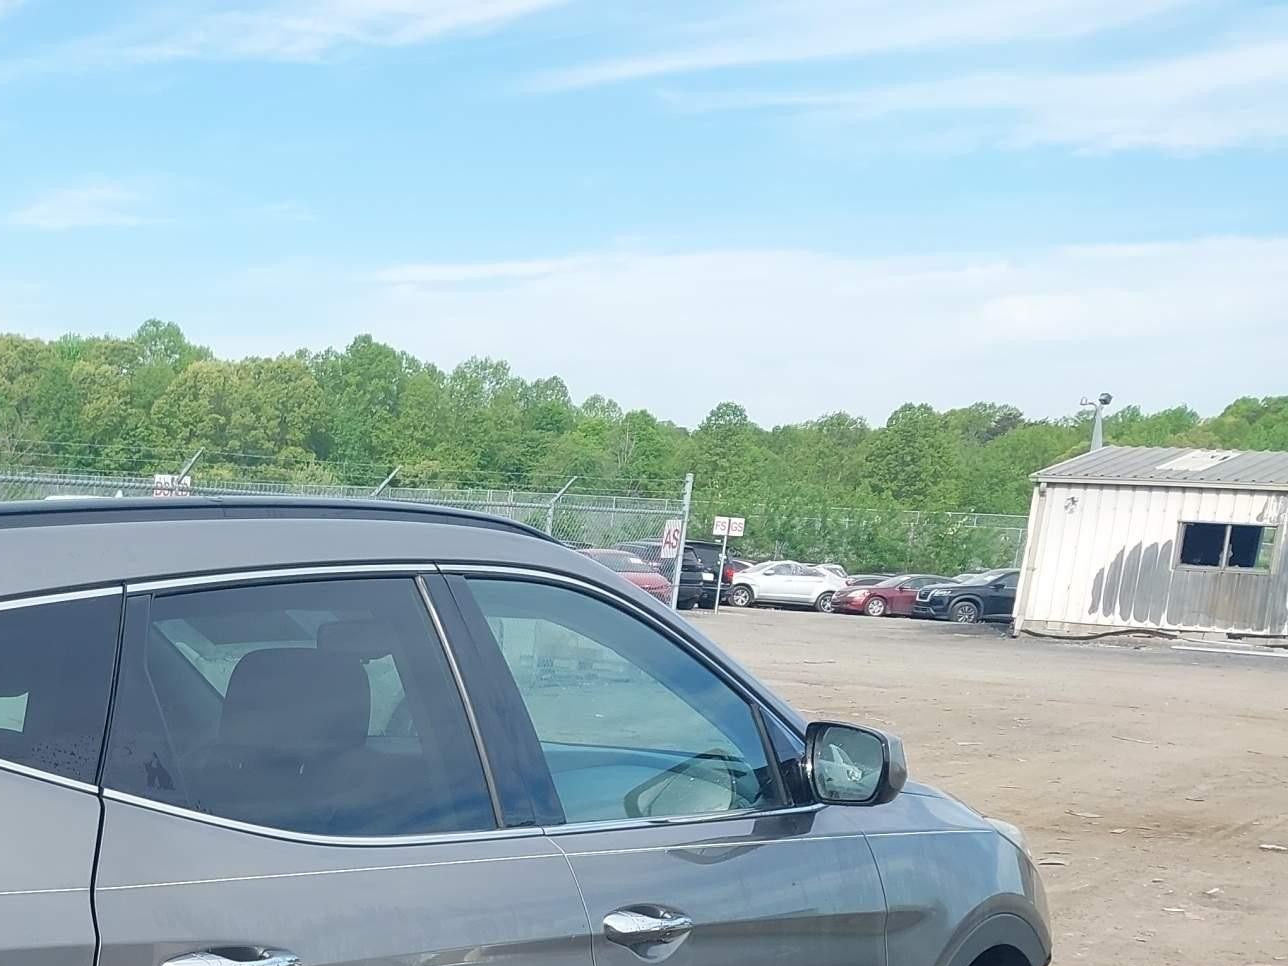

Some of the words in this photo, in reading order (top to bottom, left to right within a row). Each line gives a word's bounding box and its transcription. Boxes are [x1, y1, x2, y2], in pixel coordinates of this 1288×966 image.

[715, 520, 727, 532] FS
[730, 521, 744, 533] GS
[663, 528, 680, 549] AS
